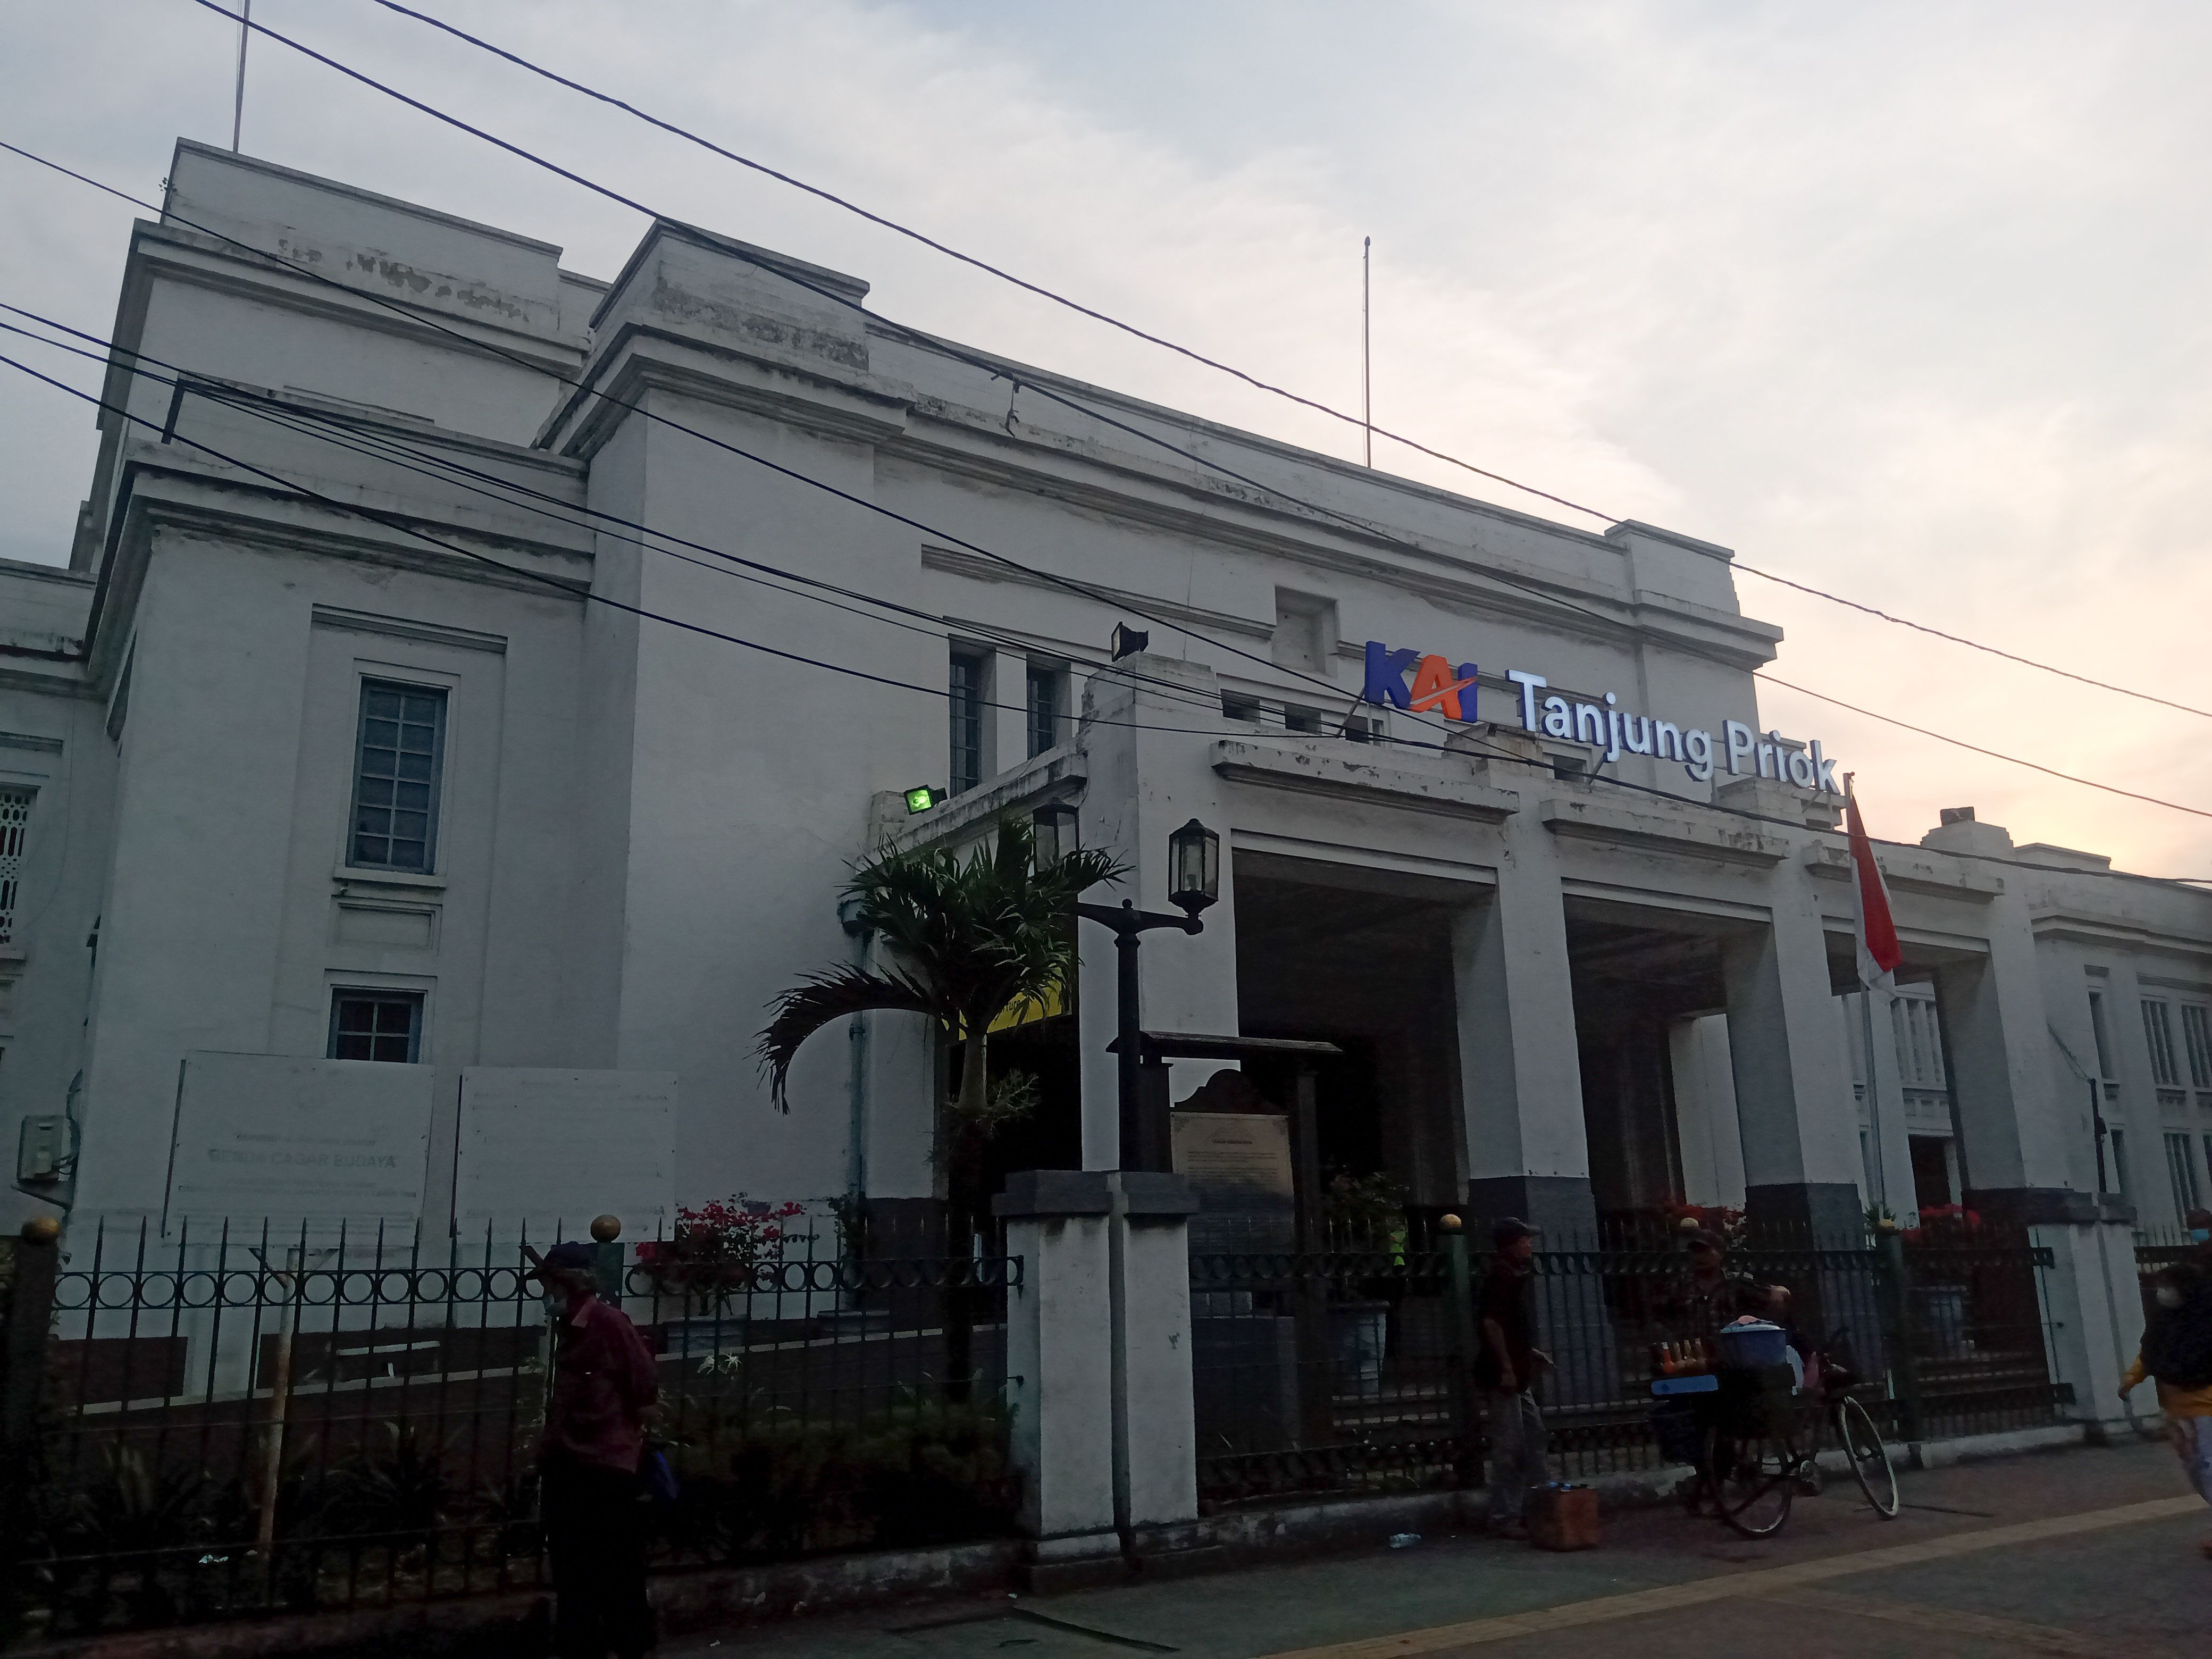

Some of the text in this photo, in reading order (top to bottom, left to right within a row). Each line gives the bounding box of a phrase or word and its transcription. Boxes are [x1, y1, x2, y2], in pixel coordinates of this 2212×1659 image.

[1365, 641, 1841, 795] KAI Tanjung Priok
